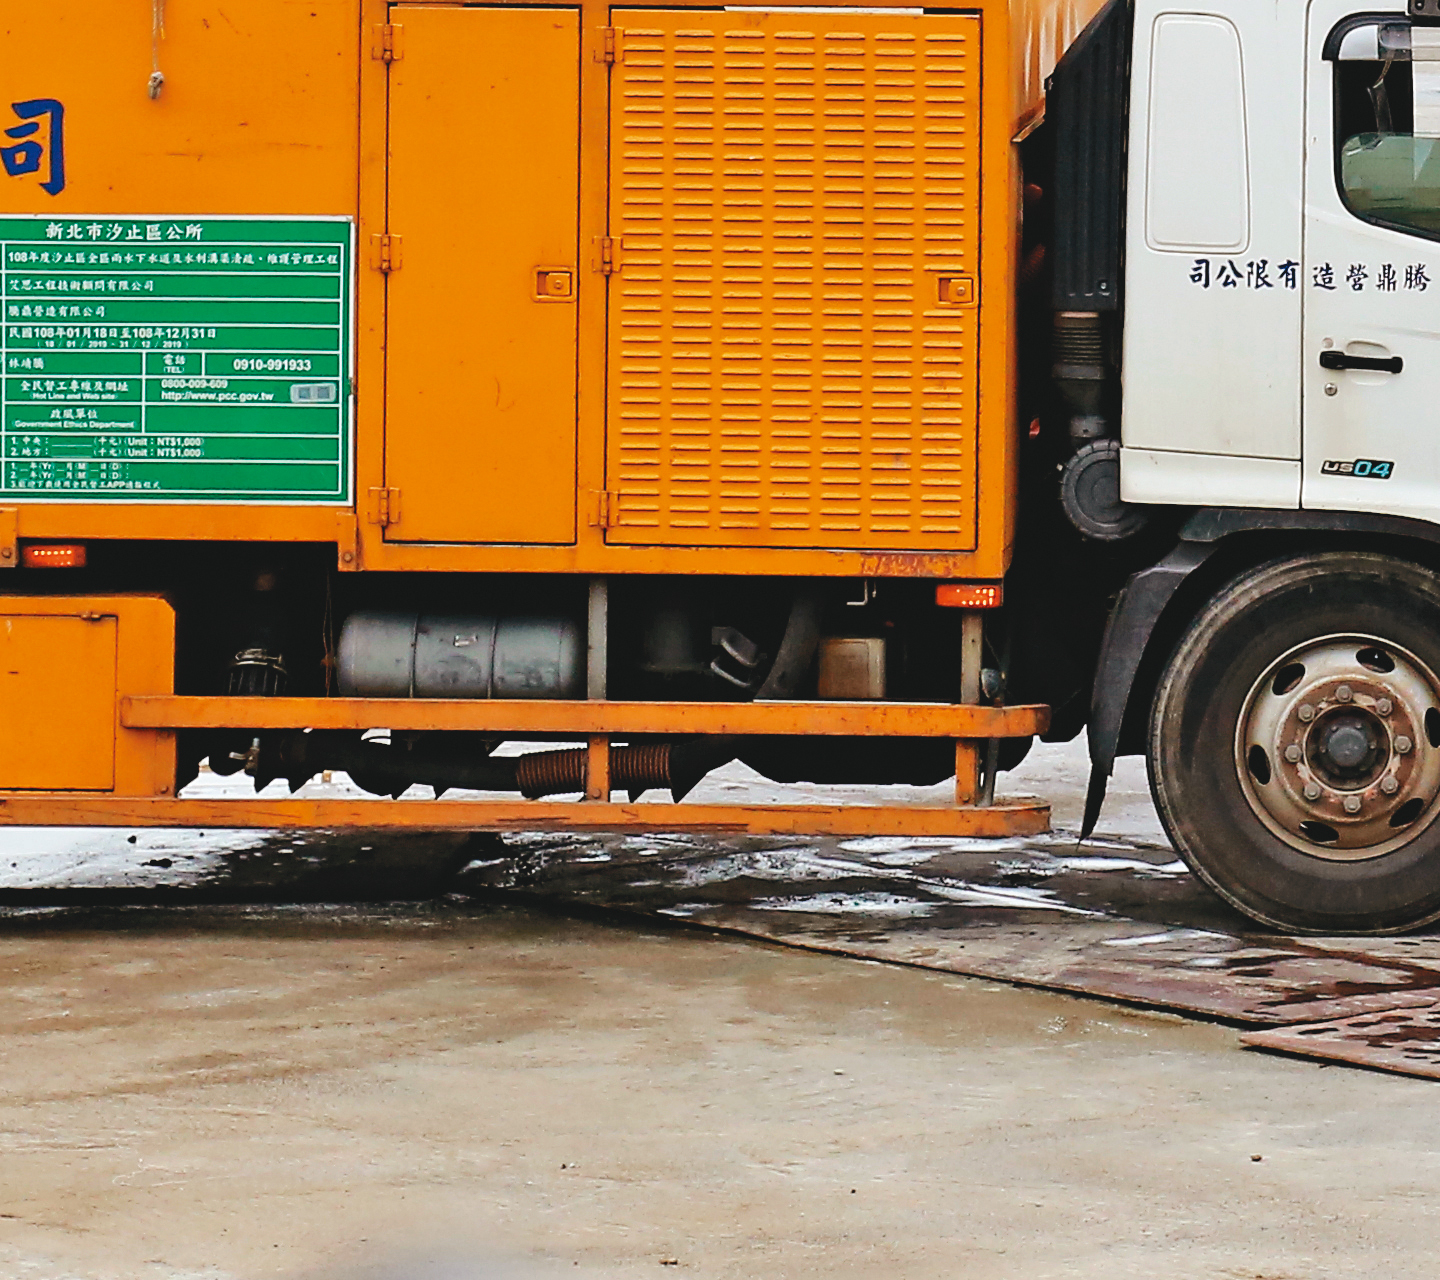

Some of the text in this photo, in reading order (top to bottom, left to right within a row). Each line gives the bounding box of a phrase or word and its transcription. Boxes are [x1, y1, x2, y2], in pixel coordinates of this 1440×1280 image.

[45, 222, 203, 240] 新北市汐止區公所
[8, 305, 106, 318] 騰鼎營造有限公司
[9, 326, 217, 339] 民國108年01月18日至108年12月31日
[163, 354, 186, 366] 電話
[232, 359, 311, 371] 0910-991933
[160, 391, 275, 402] http://www.pcc.gov.tw
[50, 408, 98, 419] 政風單位
